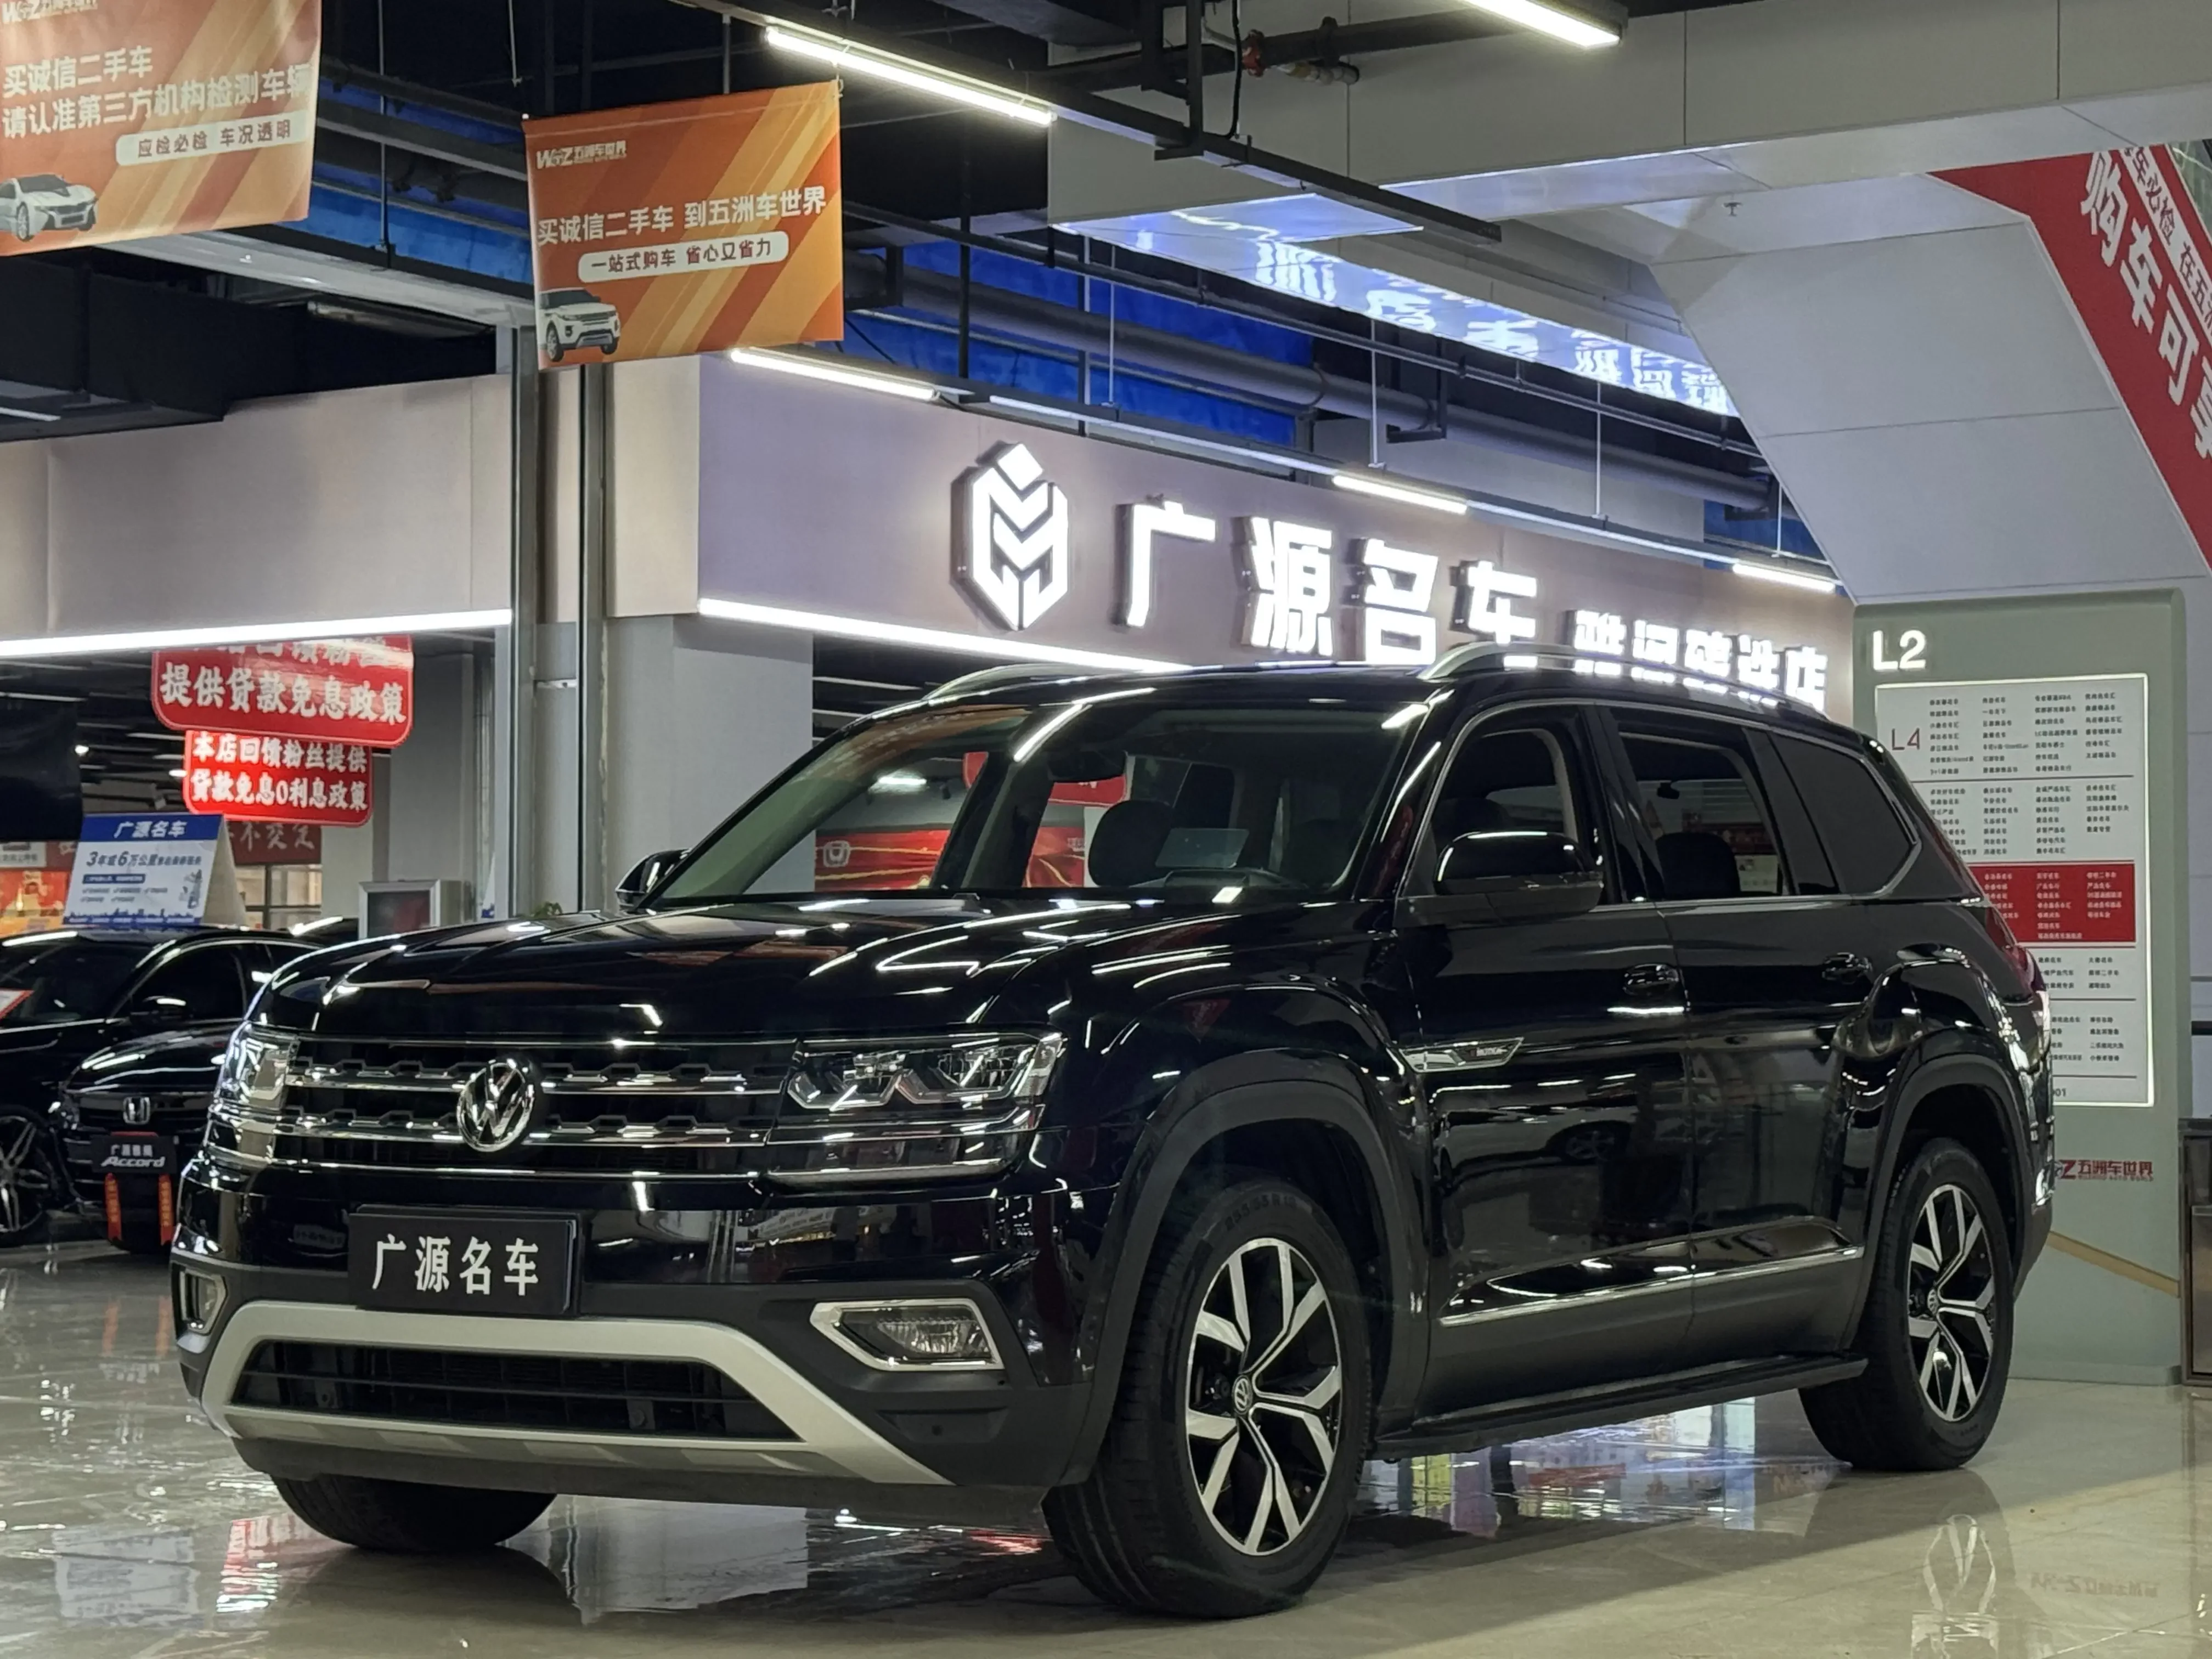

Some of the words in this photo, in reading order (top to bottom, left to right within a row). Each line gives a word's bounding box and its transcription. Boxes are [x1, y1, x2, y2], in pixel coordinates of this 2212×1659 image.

[2, 46, 153, 98] 买诚信二手车
[2, 63, 314, 139] 请认准第三方机构检测车辆
[138, 132, 208, 158] 应检必检
[220, 120, 291, 146] 车况透明
[537, 205, 674, 246] 买诚信二手车
[684, 185, 827, 230] 到五洲车世界
[591, 249, 676, 273] 一站式购车
[686, 238, 771, 265] 省心又省力
[1127, 500, 1537, 663] 广源名车
[1873, 630, 1926, 670] L2
[160, 661, 407, 726] 提供贷款免息政策
[193, 730, 368, 775] 本店回馈粉丝提供
[1892, 727, 1921, 751] L4
[190, 768, 368, 813] 贷款免息0利息政策
[113, 820, 188, 839] 广源名车
[100, 1156, 166, 1168] Accord
[2078, 1160, 2153, 1176] 五洲车世界
[371, 1234, 539, 1296] 广源名车
